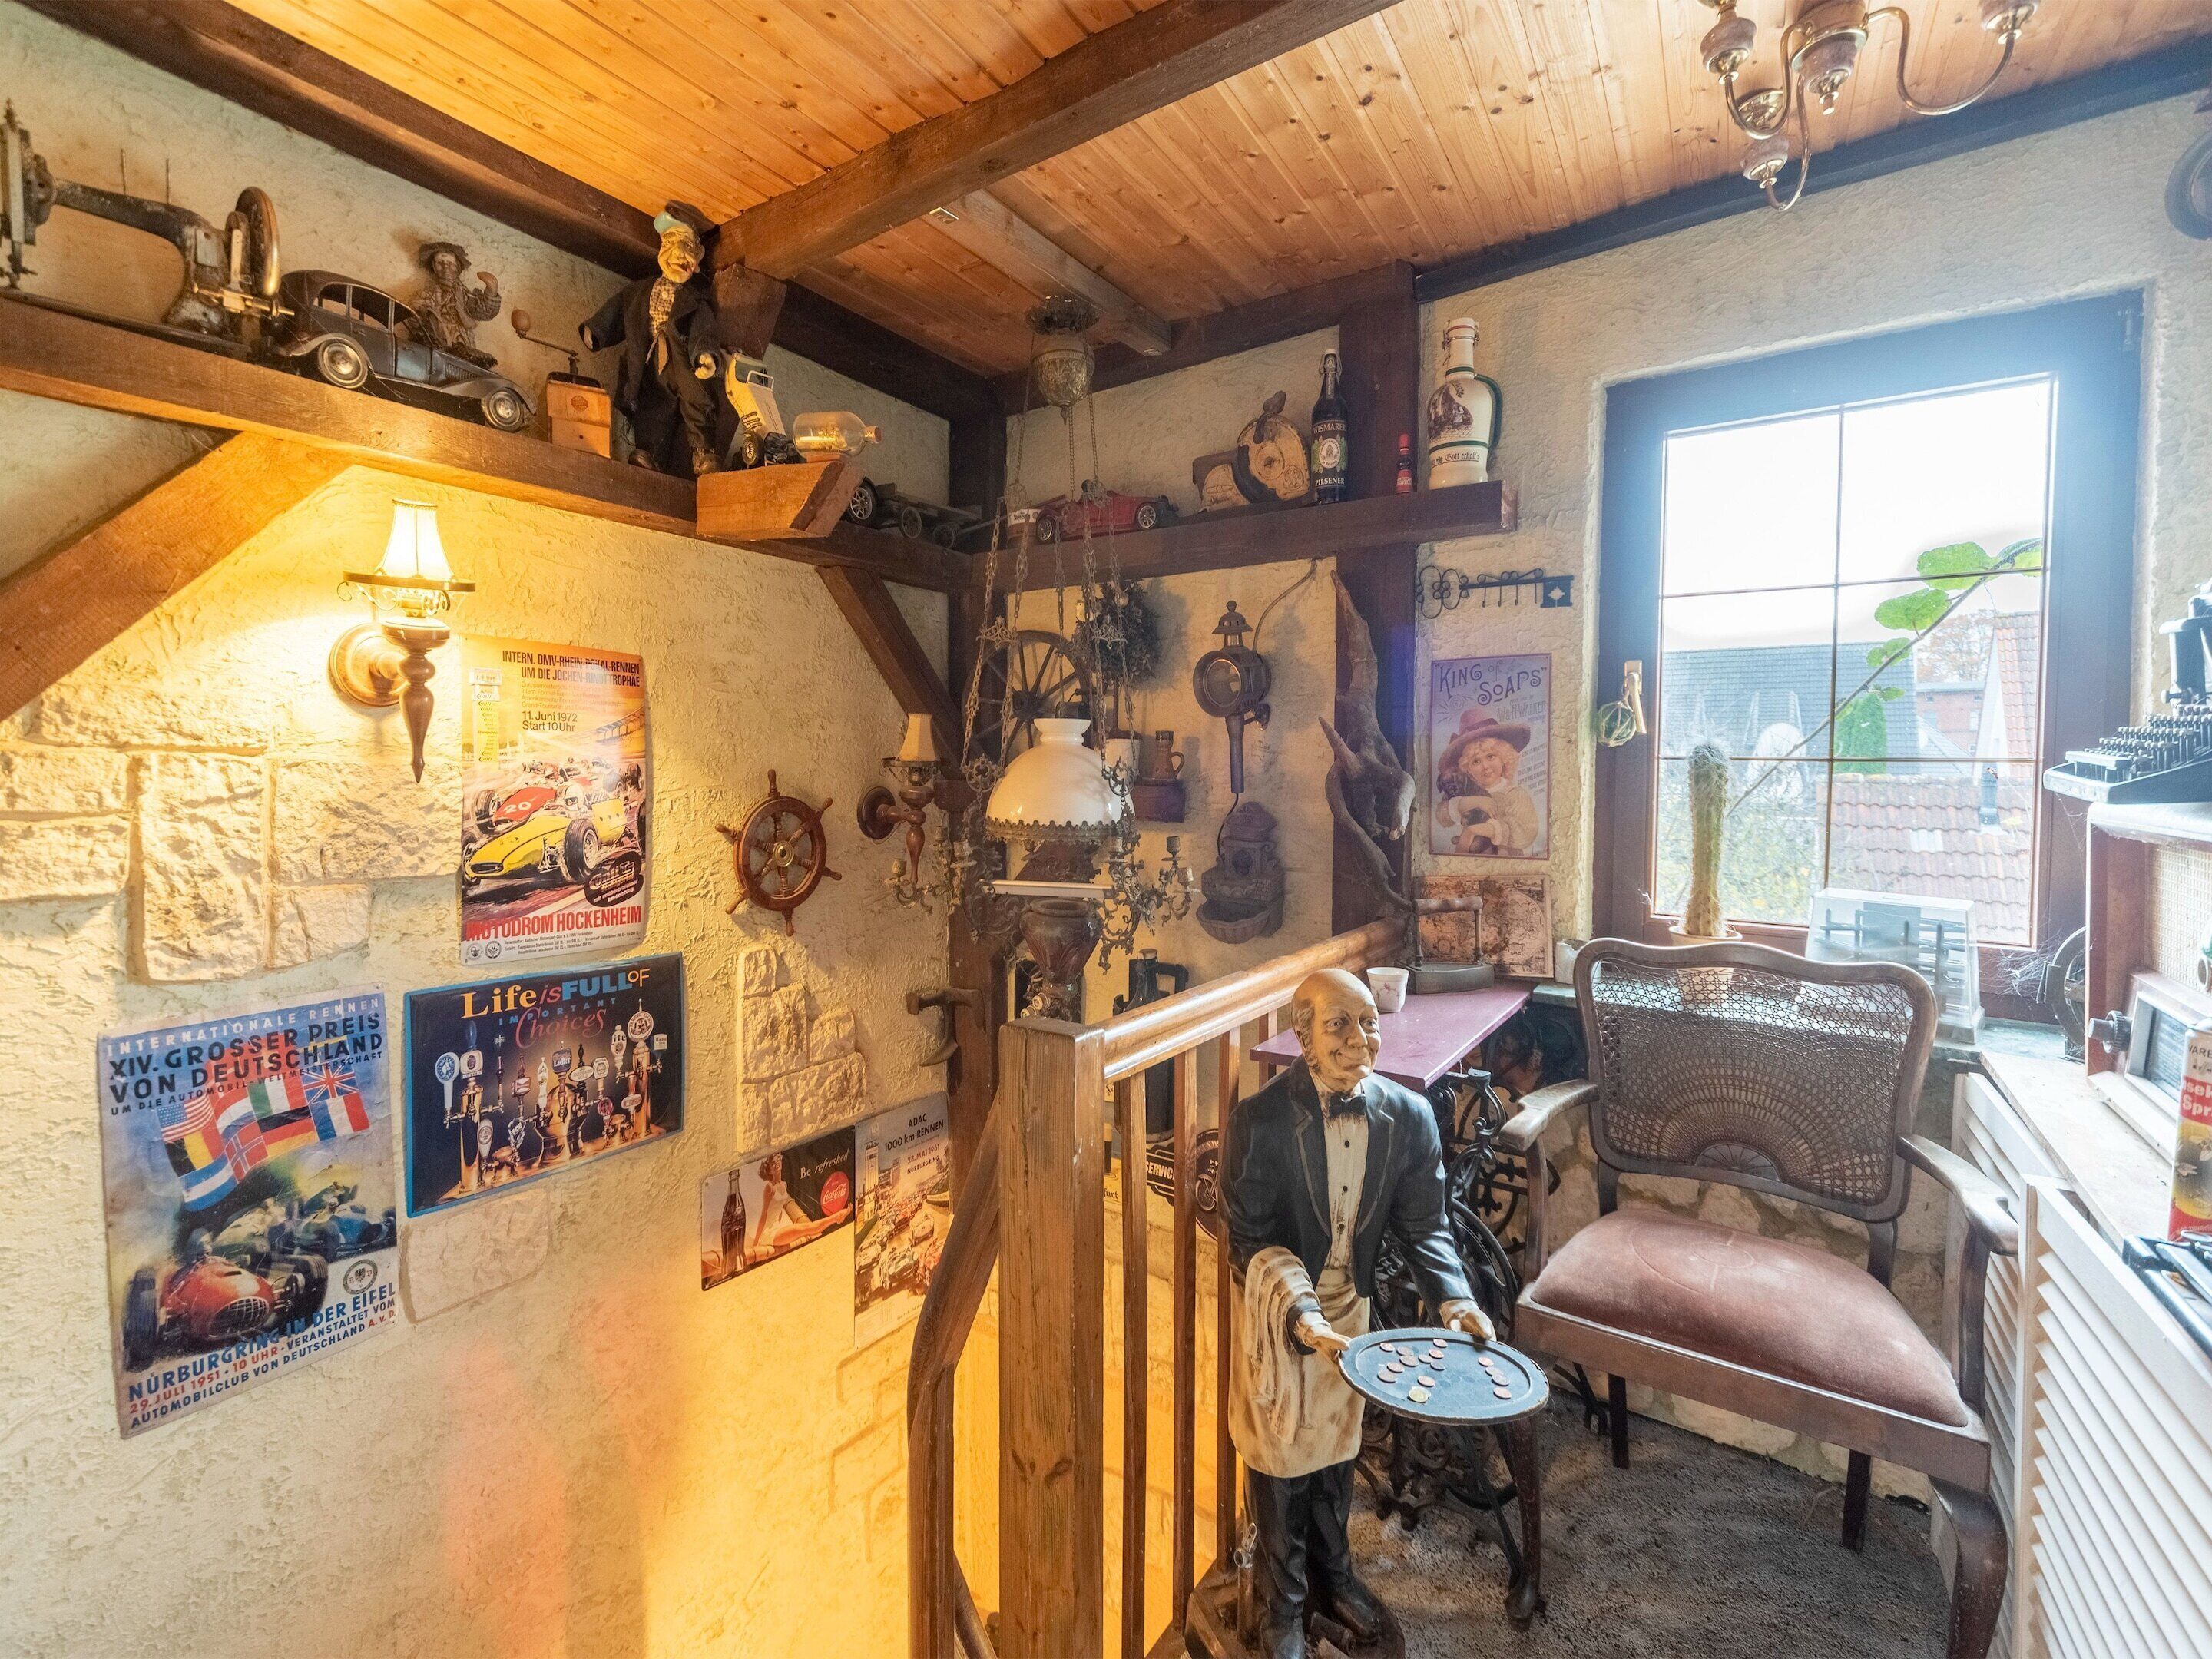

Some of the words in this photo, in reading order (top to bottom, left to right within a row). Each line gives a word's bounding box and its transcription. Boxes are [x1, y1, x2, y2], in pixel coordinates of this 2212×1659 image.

[1315, 477, 1345, 486] PILSENER
[502, 651, 536, 665] INTERN.
[521, 667, 535, 679] UM
[538, 668, 551, 680] DIE
[522, 710, 533, 720] 11.
[535, 710, 555, 721] Juni
[558, 712, 578, 723] 1972
[522, 720, 545, 731] Start
[547, 721, 558, 731] 10
[559, 721, 575, 732] Uhr
[503, 801, 532, 815] 20
[465, 914, 553, 942] MOTODROM
[557, 906, 642, 931] HOCKENHEIM
[461, 984, 537, 1019] Life
[539, 984, 562, 1005] is
[561, 972, 633, 1002] FULL
[628, 968, 651, 988] OF
[107, 1013, 296, 1058] INTERNATIONALE
[309, 998, 379, 1020] RENNEN
[498, 998, 616, 1026] IMPORTANT
[515, 1006, 607, 1050] Choices
[108, 1054, 160, 1079] XIV.
[164, 1028, 298, 1068] GROSSER
[308, 1013, 381, 1041] PREIS
[109, 1078, 176, 1104] VON
[191, 1033, 382, 1085] DEUTSCHLAND
[111, 1105, 132, 1116] UM
[138, 1098, 163, 1111] DIE
[168, 1051, 382, 1104] AUTOMOBIL-WELTMEISTERSCHAFT
[884, 1137, 903, 1152] 1000
[904, 1134, 915, 1144] km
[916, 1119, 944, 1138] RENNEN
[908, 1113, 927, 1128] ADAC
[800, 1167, 812, 1180] Be
[814, 1147, 849, 1174] refreshed
[916, 1150, 928, 1159] MAI
[929, 1144, 940, 1154] 1961
[1146, 1161, 1174, 1181] SERVIC
[128, 1327, 280, 1402] NÜRBURGRING
[312, 1301, 346, 1328] DER
[353, 1282, 396, 1312] EIFEL
[129, 1399, 152, 1414] 29.
[154, 1384, 185, 1405] JULI
[190, 1369, 220, 1389] 1951
[232, 1359, 247, 1373] 10
[251, 1346, 278, 1364] UHR
[286, 1309, 369, 1350] VERANSTALTET
[373, 1298, 396, 1315] VOM
[131, 1372, 250, 1429] AUTOMOBILCLUB
[253, 1359, 279, 1377] VON
[283, 1323, 366, 1365] DEUTSCHLAND
